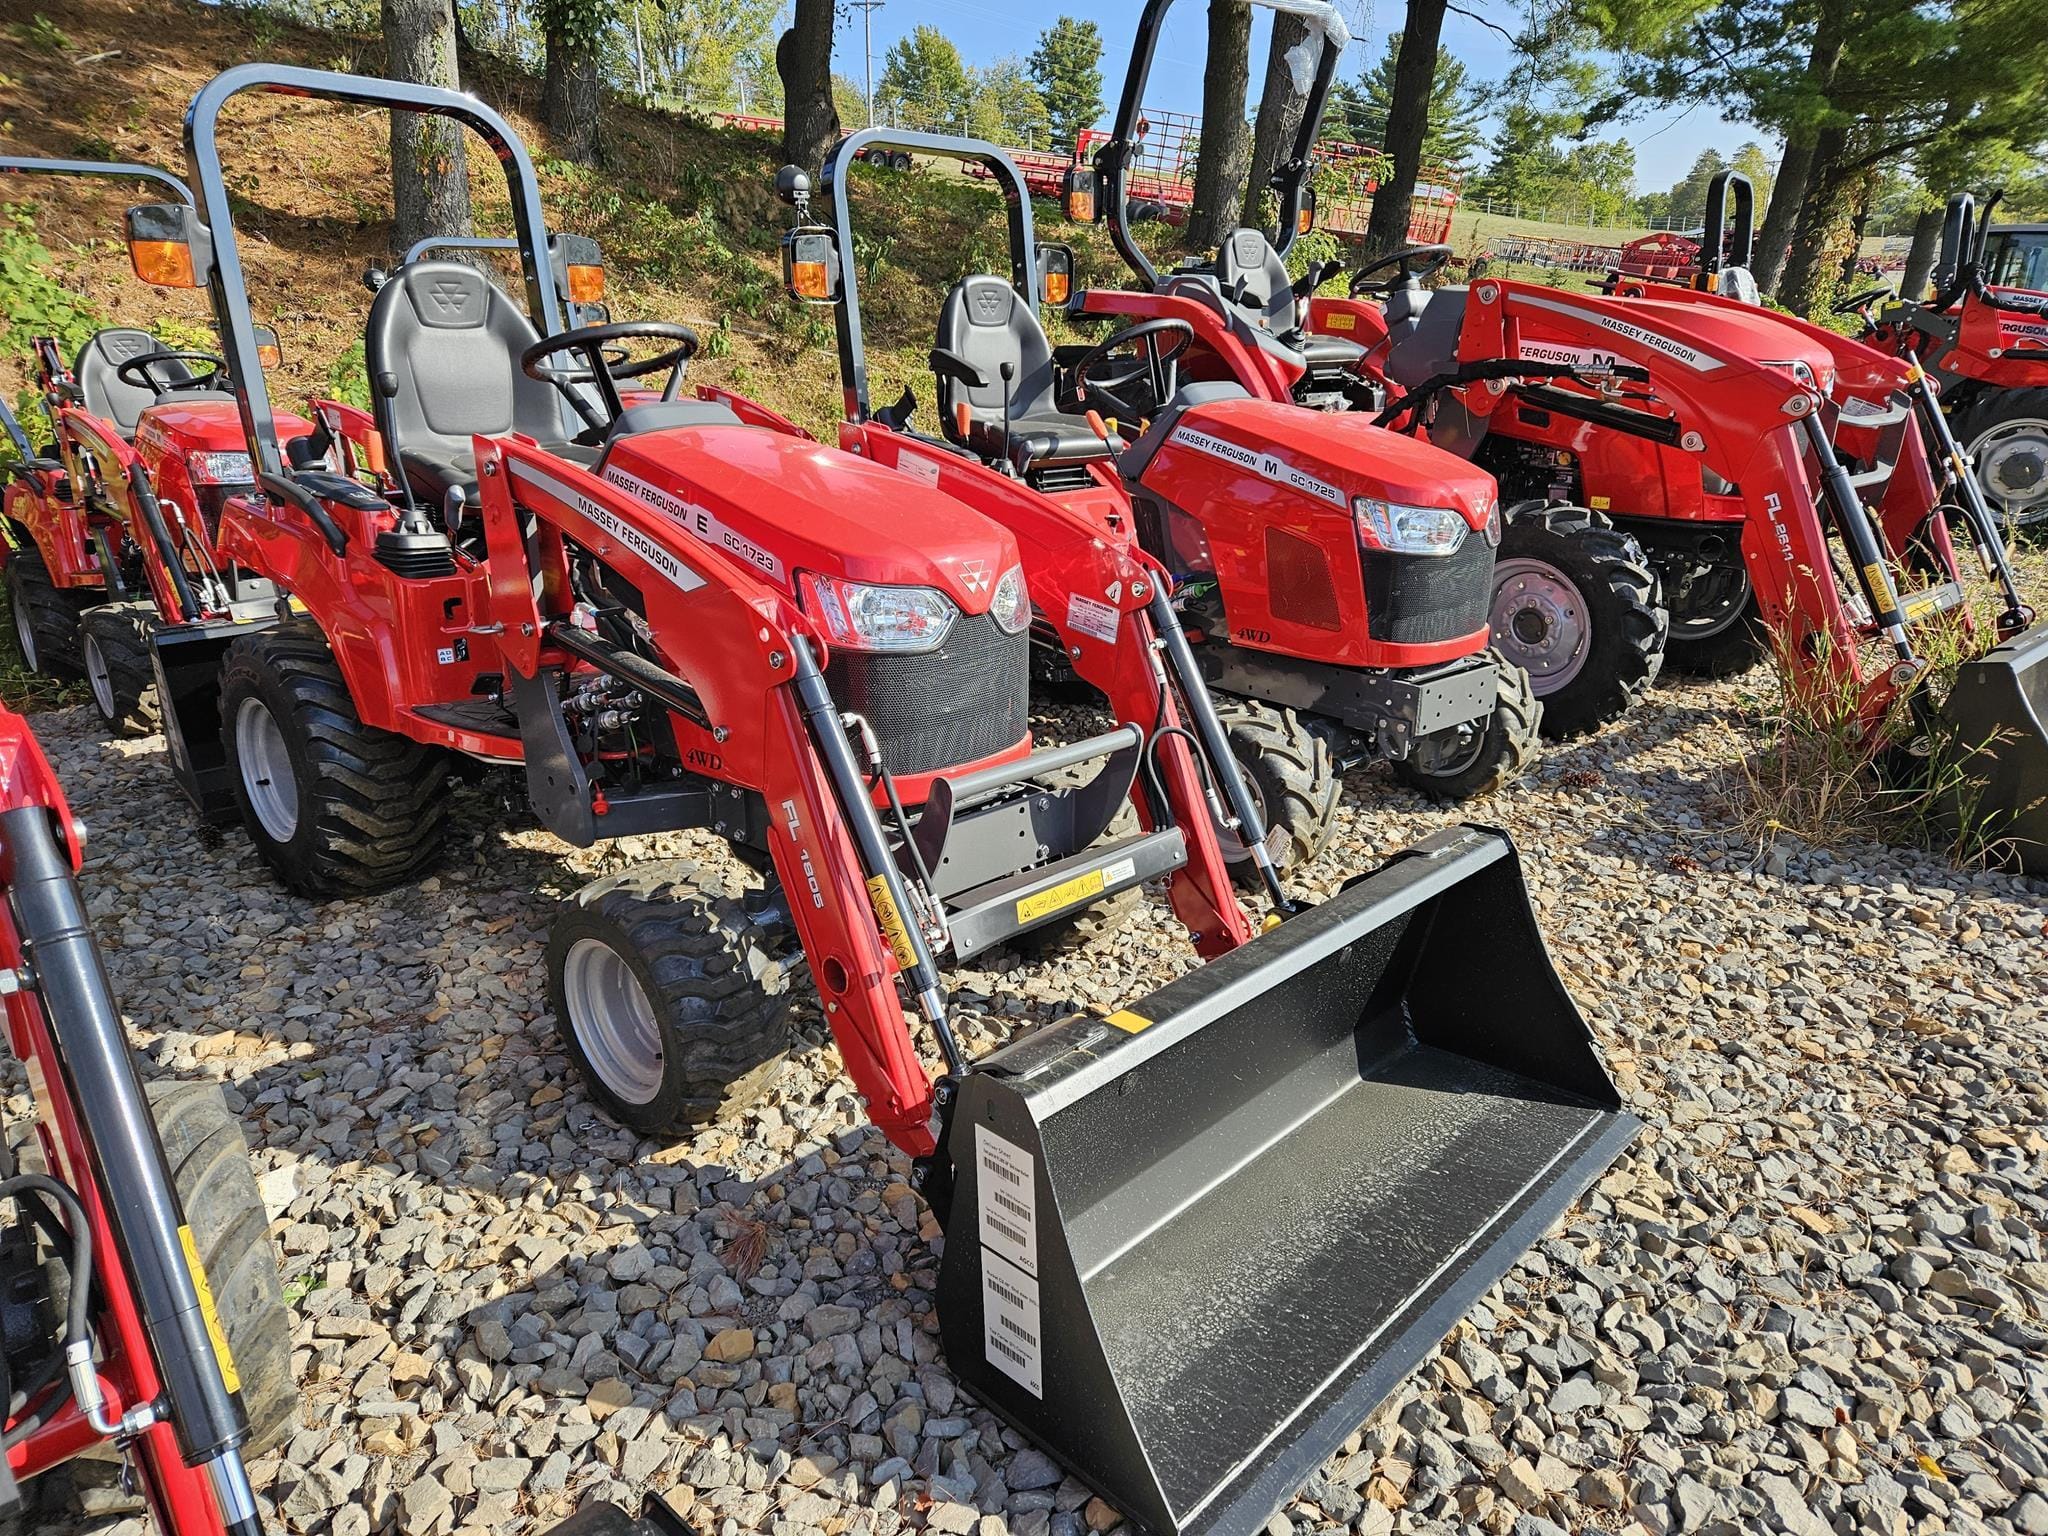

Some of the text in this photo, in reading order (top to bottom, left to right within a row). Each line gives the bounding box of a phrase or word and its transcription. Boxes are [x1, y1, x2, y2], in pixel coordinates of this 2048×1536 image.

[1520, 346, 1580, 364] FERGUSON
[1601, 317, 1697, 362] MASSEY FERGUSON
[1177, 431, 1211, 449] MASSEY
[1211, 442, 1258, 467] FERGUSON
[1264, 460, 1278, 475] M
[1307, 480, 1336, 499] 1725
[578, 497, 678, 577] MASSEY FERGUSON
[607, 470, 640, 495] MASSEY
[641, 487, 688, 521] FERGUSON
[696, 513, 708, 534] E
[742, 544, 775, 571] 1723
[1764, 492, 1794, 561] FL 2611
[1075, 596, 1091, 606] MASSEY
[1236, 627, 1271, 643] 4WD
[686, 748, 722, 770] 4WD
[781, 799, 825, 910] FL 1805
[1018, 1255, 1035, 1269] AGCO
